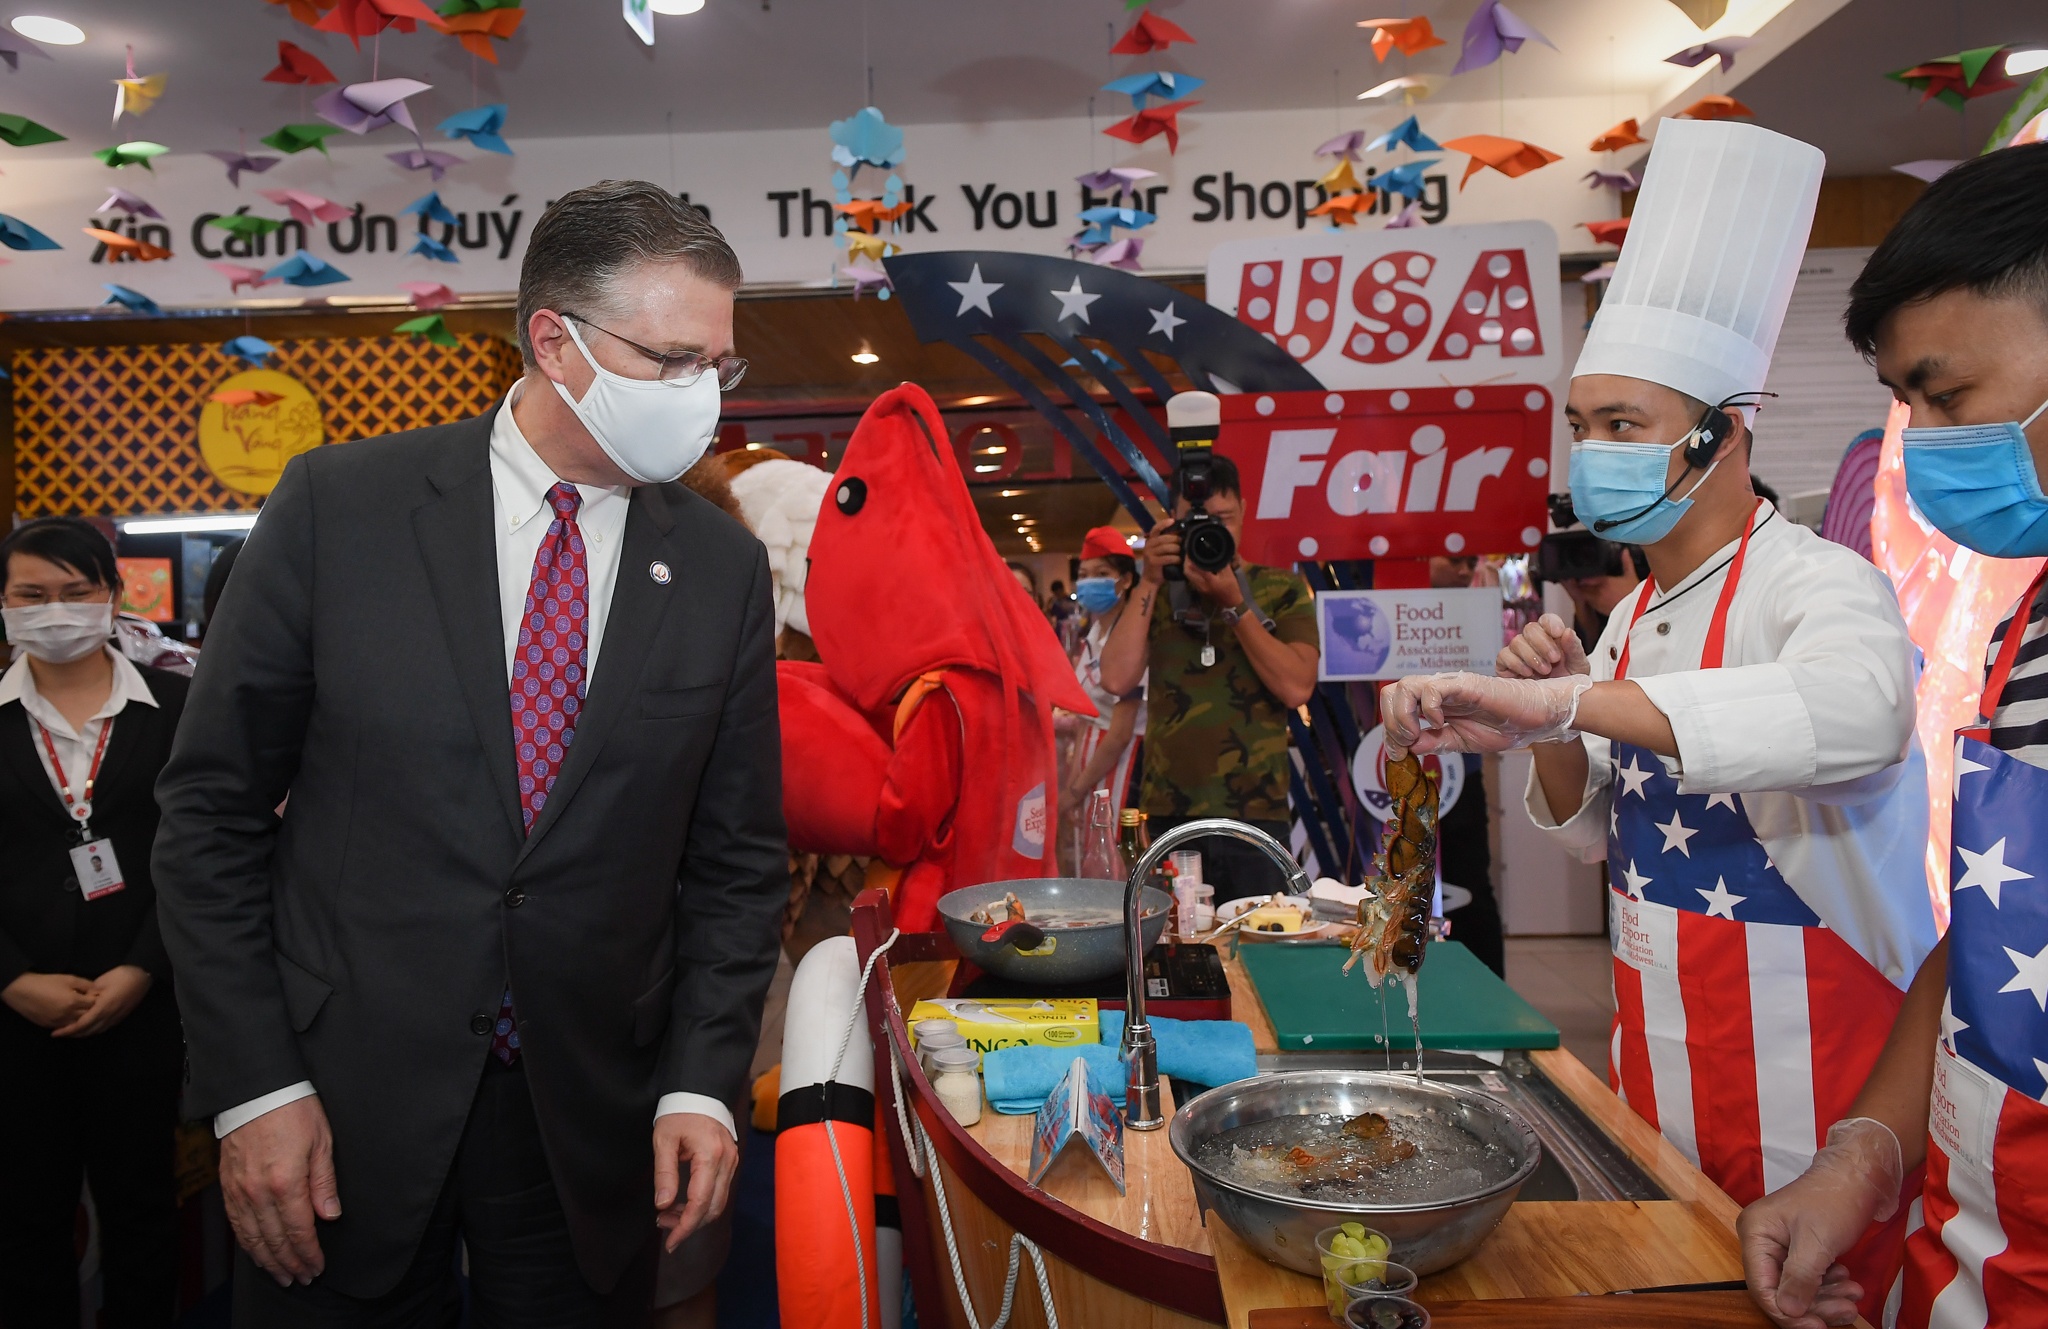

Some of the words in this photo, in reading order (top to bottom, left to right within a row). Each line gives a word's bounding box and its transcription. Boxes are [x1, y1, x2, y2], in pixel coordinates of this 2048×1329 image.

[961, 184, 1057, 230] You
[1238, 248, 1544, 364] USA
[1256, 424, 1514, 519] Fair
[1396, 602, 1443, 621] Food
[1396, 623, 1462, 645] Export
[1396, 644, 1470, 657] Association
[1420, 656, 1469, 669] Midwest
